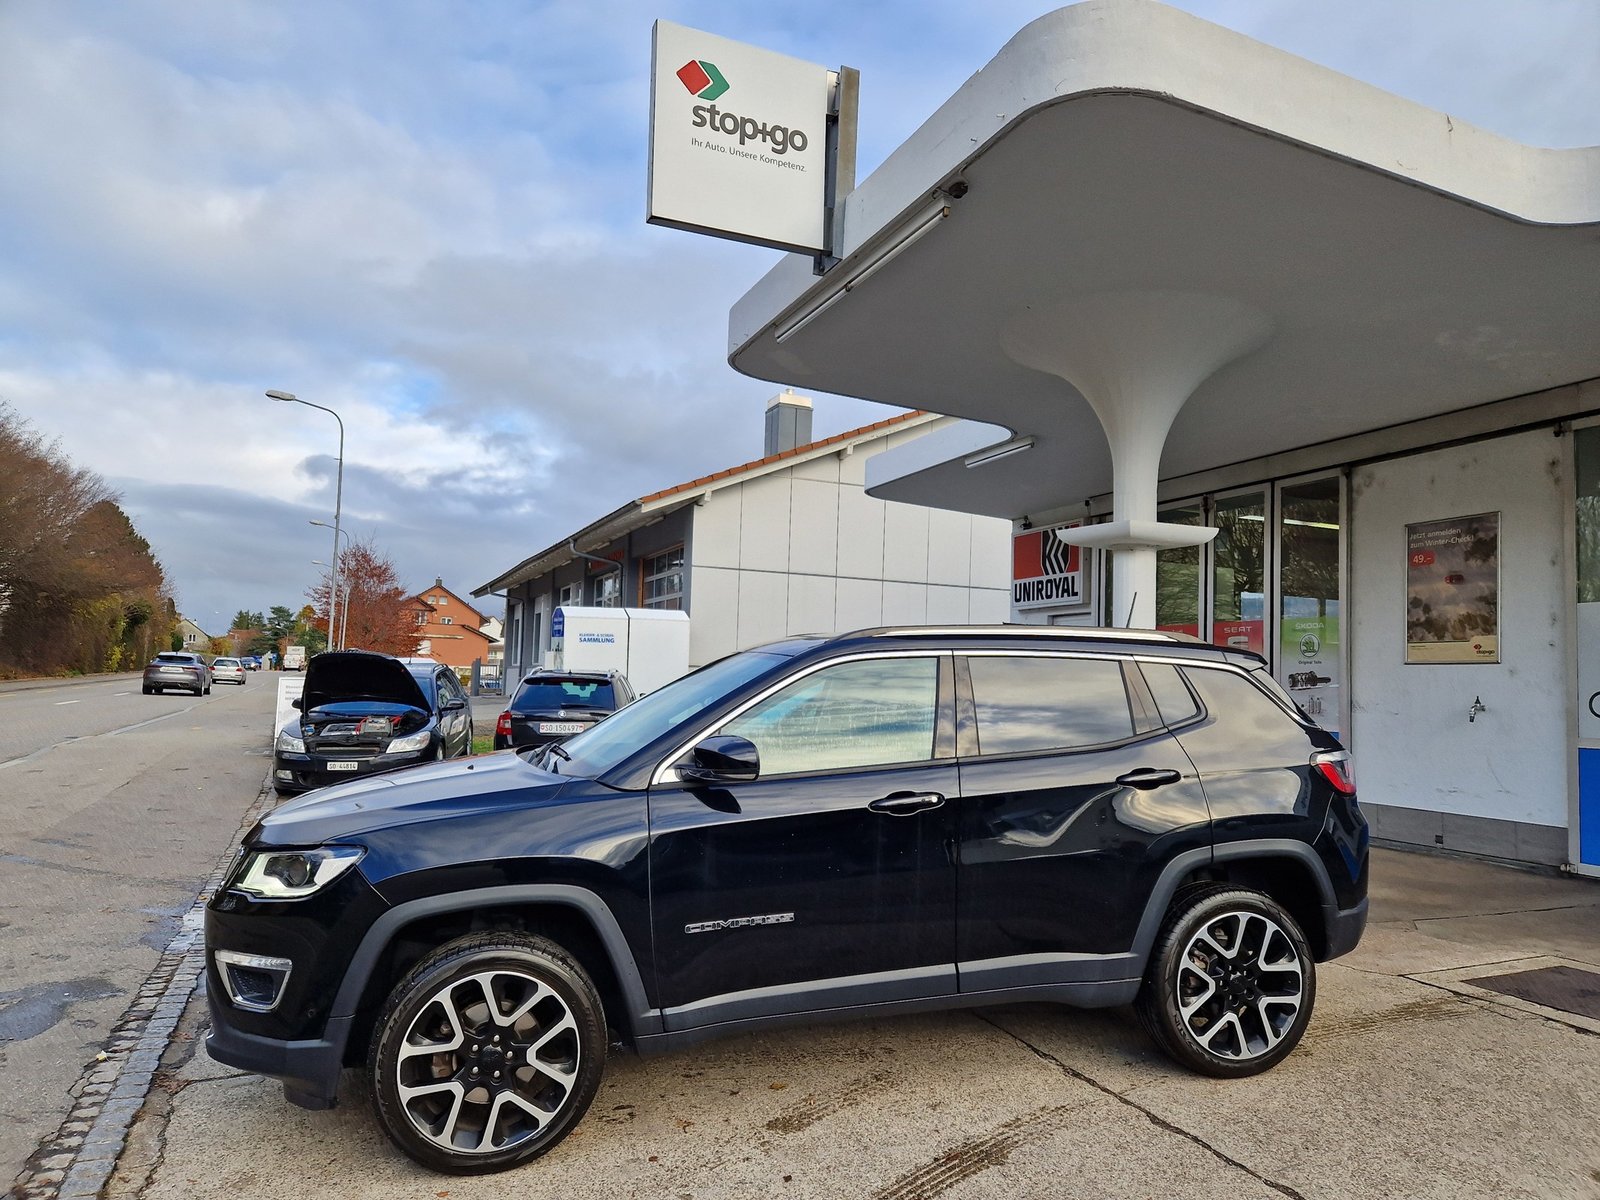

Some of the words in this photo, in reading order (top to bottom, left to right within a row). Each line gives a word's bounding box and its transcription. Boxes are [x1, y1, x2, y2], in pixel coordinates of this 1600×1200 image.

[692, 104, 808, 155] stop+go
[691, 137, 703, 147] Ihr
[705, 141, 728, 154] Auto.
[729, 147, 758, 160] Unsere
[759, 153, 807, 173] Kompetenz.
[1427, 528, 1462, 538] anmelden
[1410, 541, 1425, 549] zum
[1014, 575, 1079, 603] UNIROYAL
[1223, 625, 1253, 634] SEAT
